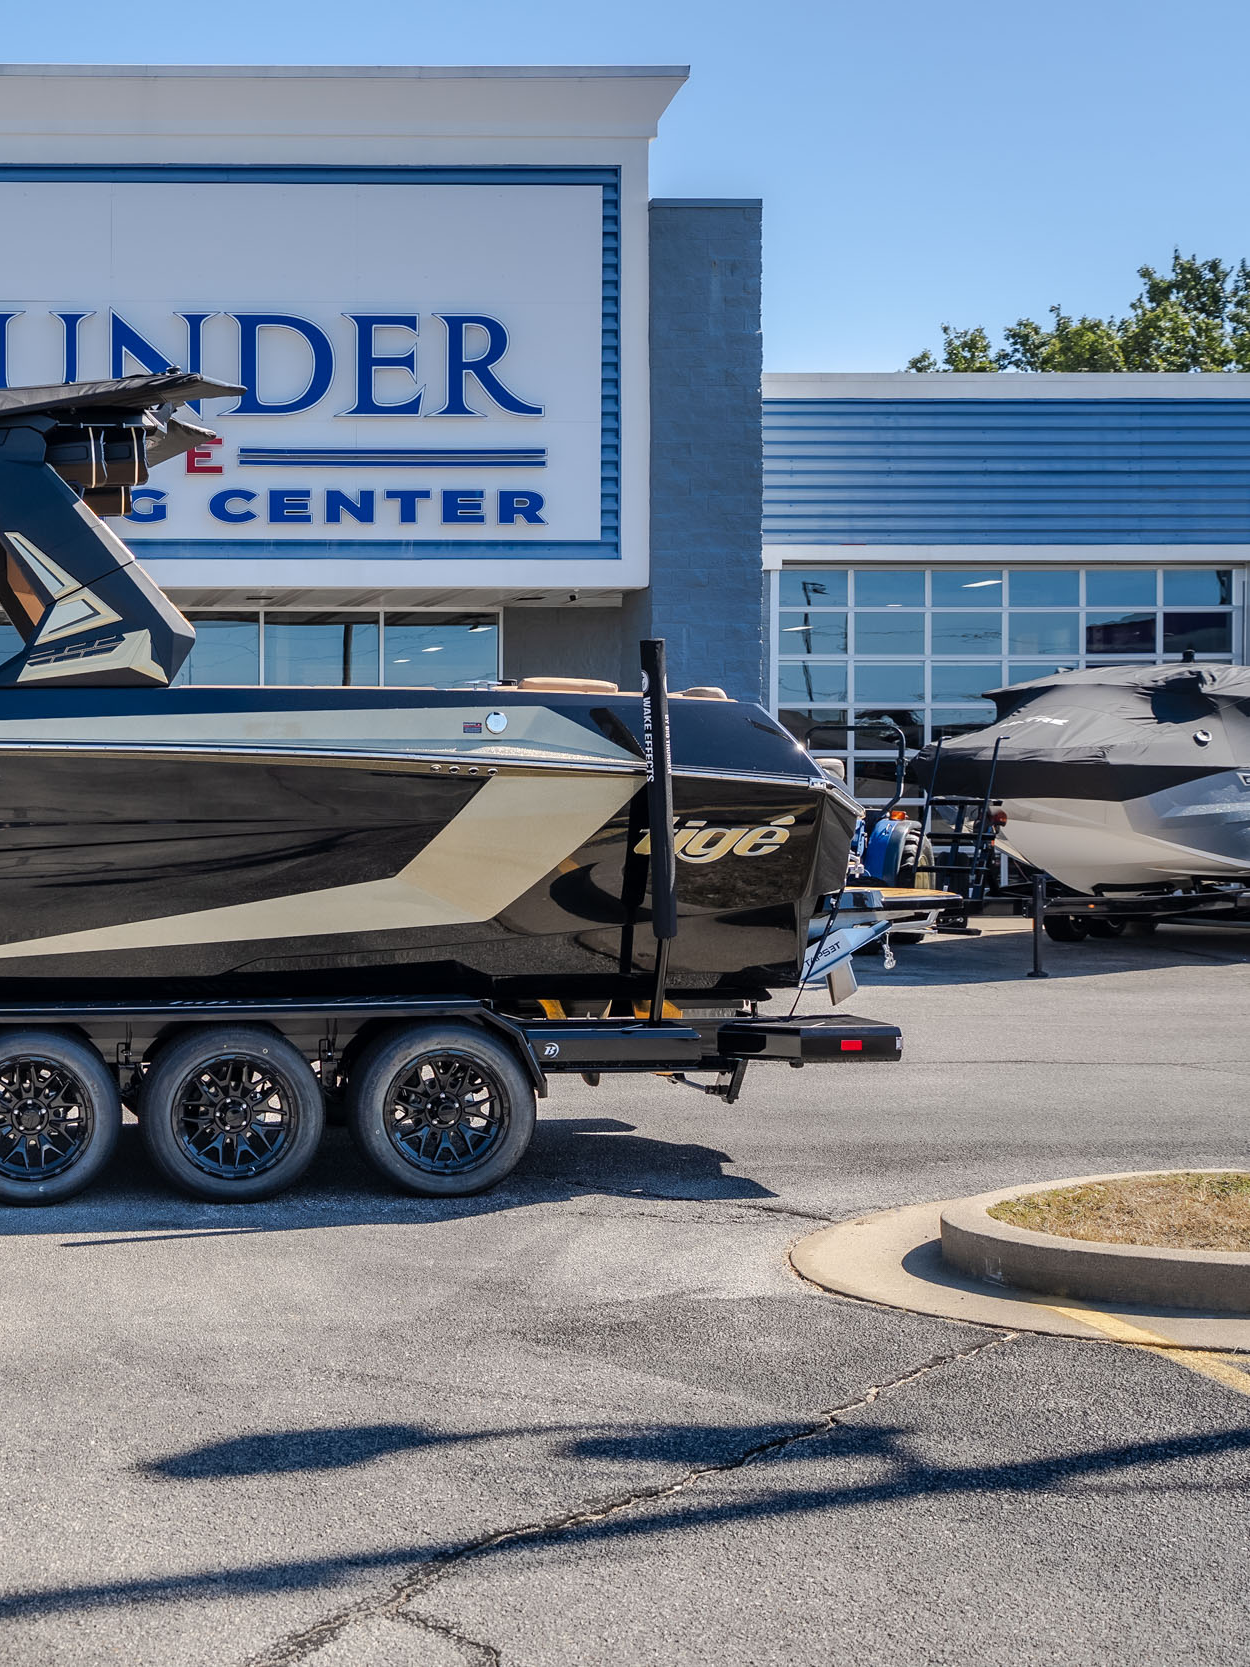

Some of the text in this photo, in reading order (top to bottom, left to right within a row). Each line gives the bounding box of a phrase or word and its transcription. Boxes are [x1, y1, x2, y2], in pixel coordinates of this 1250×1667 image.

[207, 488, 548, 525] CENTER
[643, 697, 654, 782] WAKE EFFECTS
